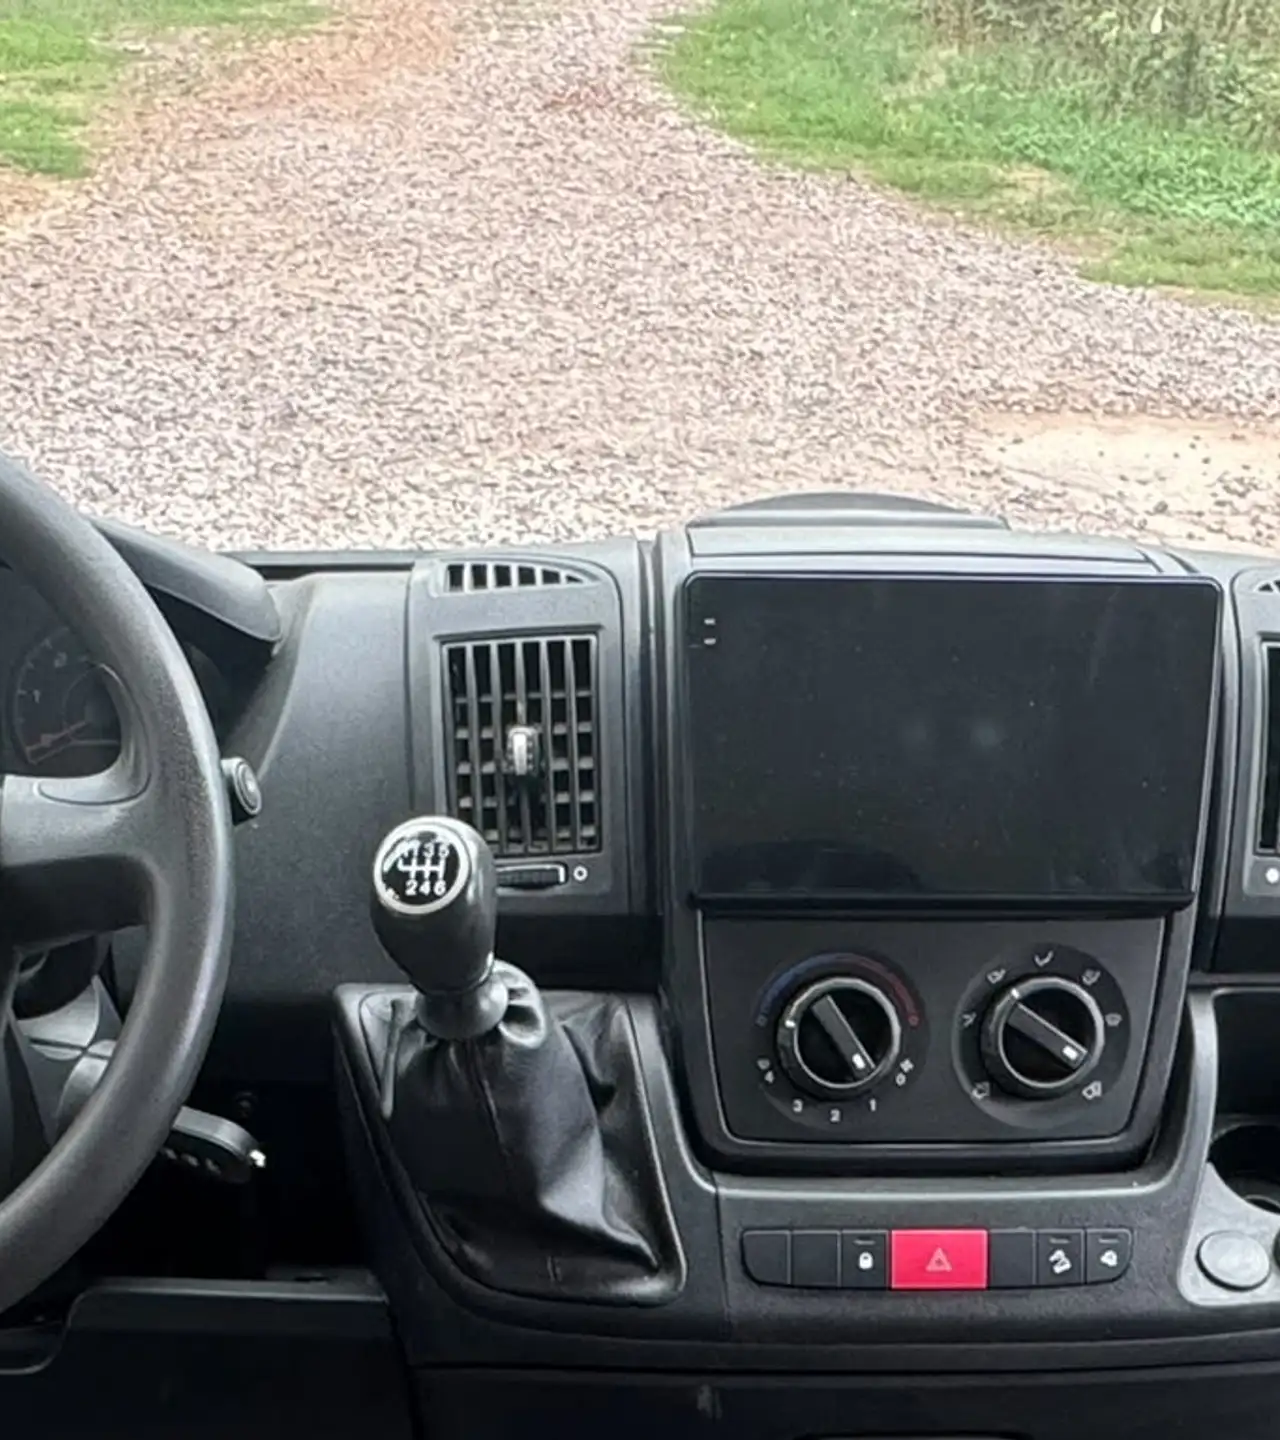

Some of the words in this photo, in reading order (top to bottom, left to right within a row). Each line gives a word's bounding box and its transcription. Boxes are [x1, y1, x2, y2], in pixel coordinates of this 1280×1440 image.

[423, 843, 434, 858] 3
[405, 879, 418, 895] 2
[419, 880, 430, 895] 4
[434, 880, 446, 896] 6
[792, 1099, 804, 1113] 3
[869, 1098, 877, 1112] 1
[829, 1109, 841, 1123] 2
